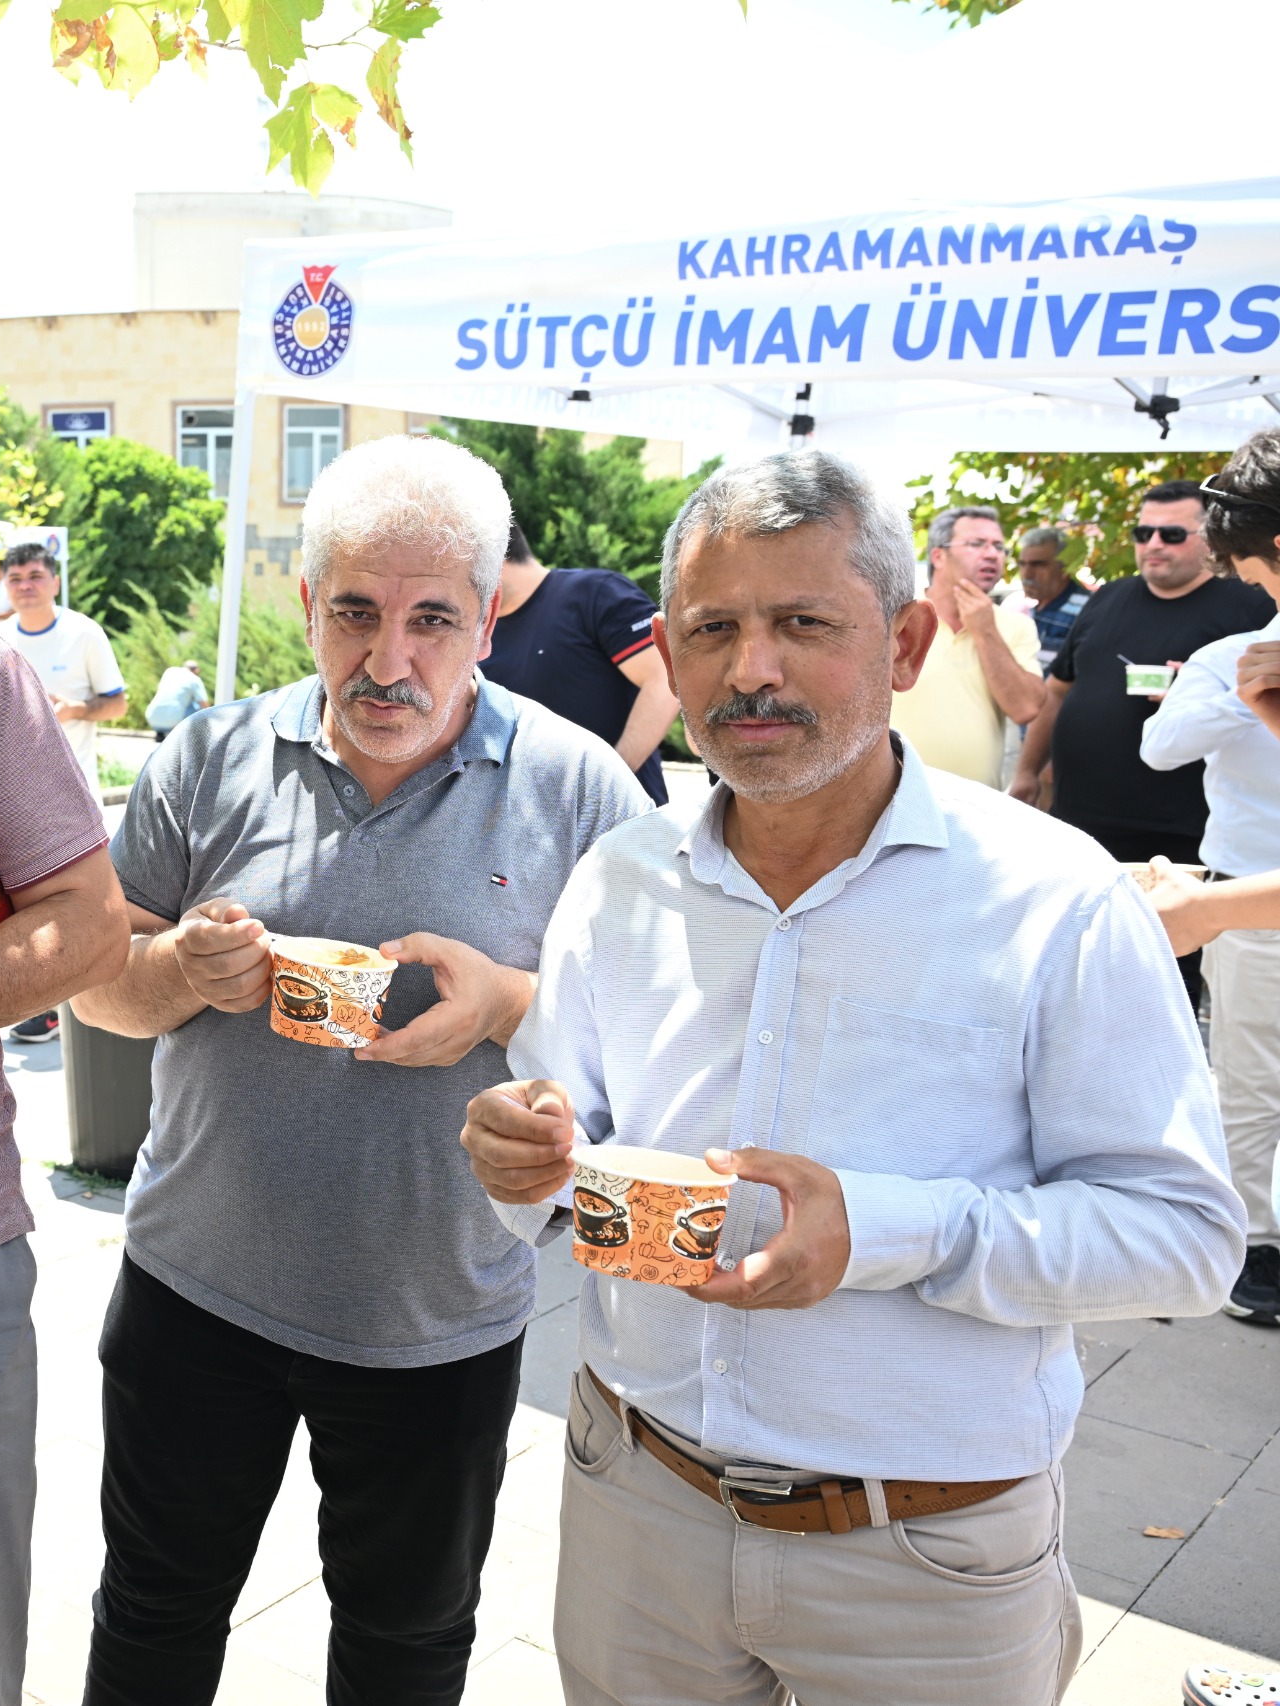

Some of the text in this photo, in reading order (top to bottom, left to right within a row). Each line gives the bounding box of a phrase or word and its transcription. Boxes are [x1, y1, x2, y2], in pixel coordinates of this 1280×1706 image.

[677, 214, 1198, 281] KAHRAMANMARAŞ
[455, 276, 1280, 383] SÜTÇÜ İMAM ÜNİVERS
